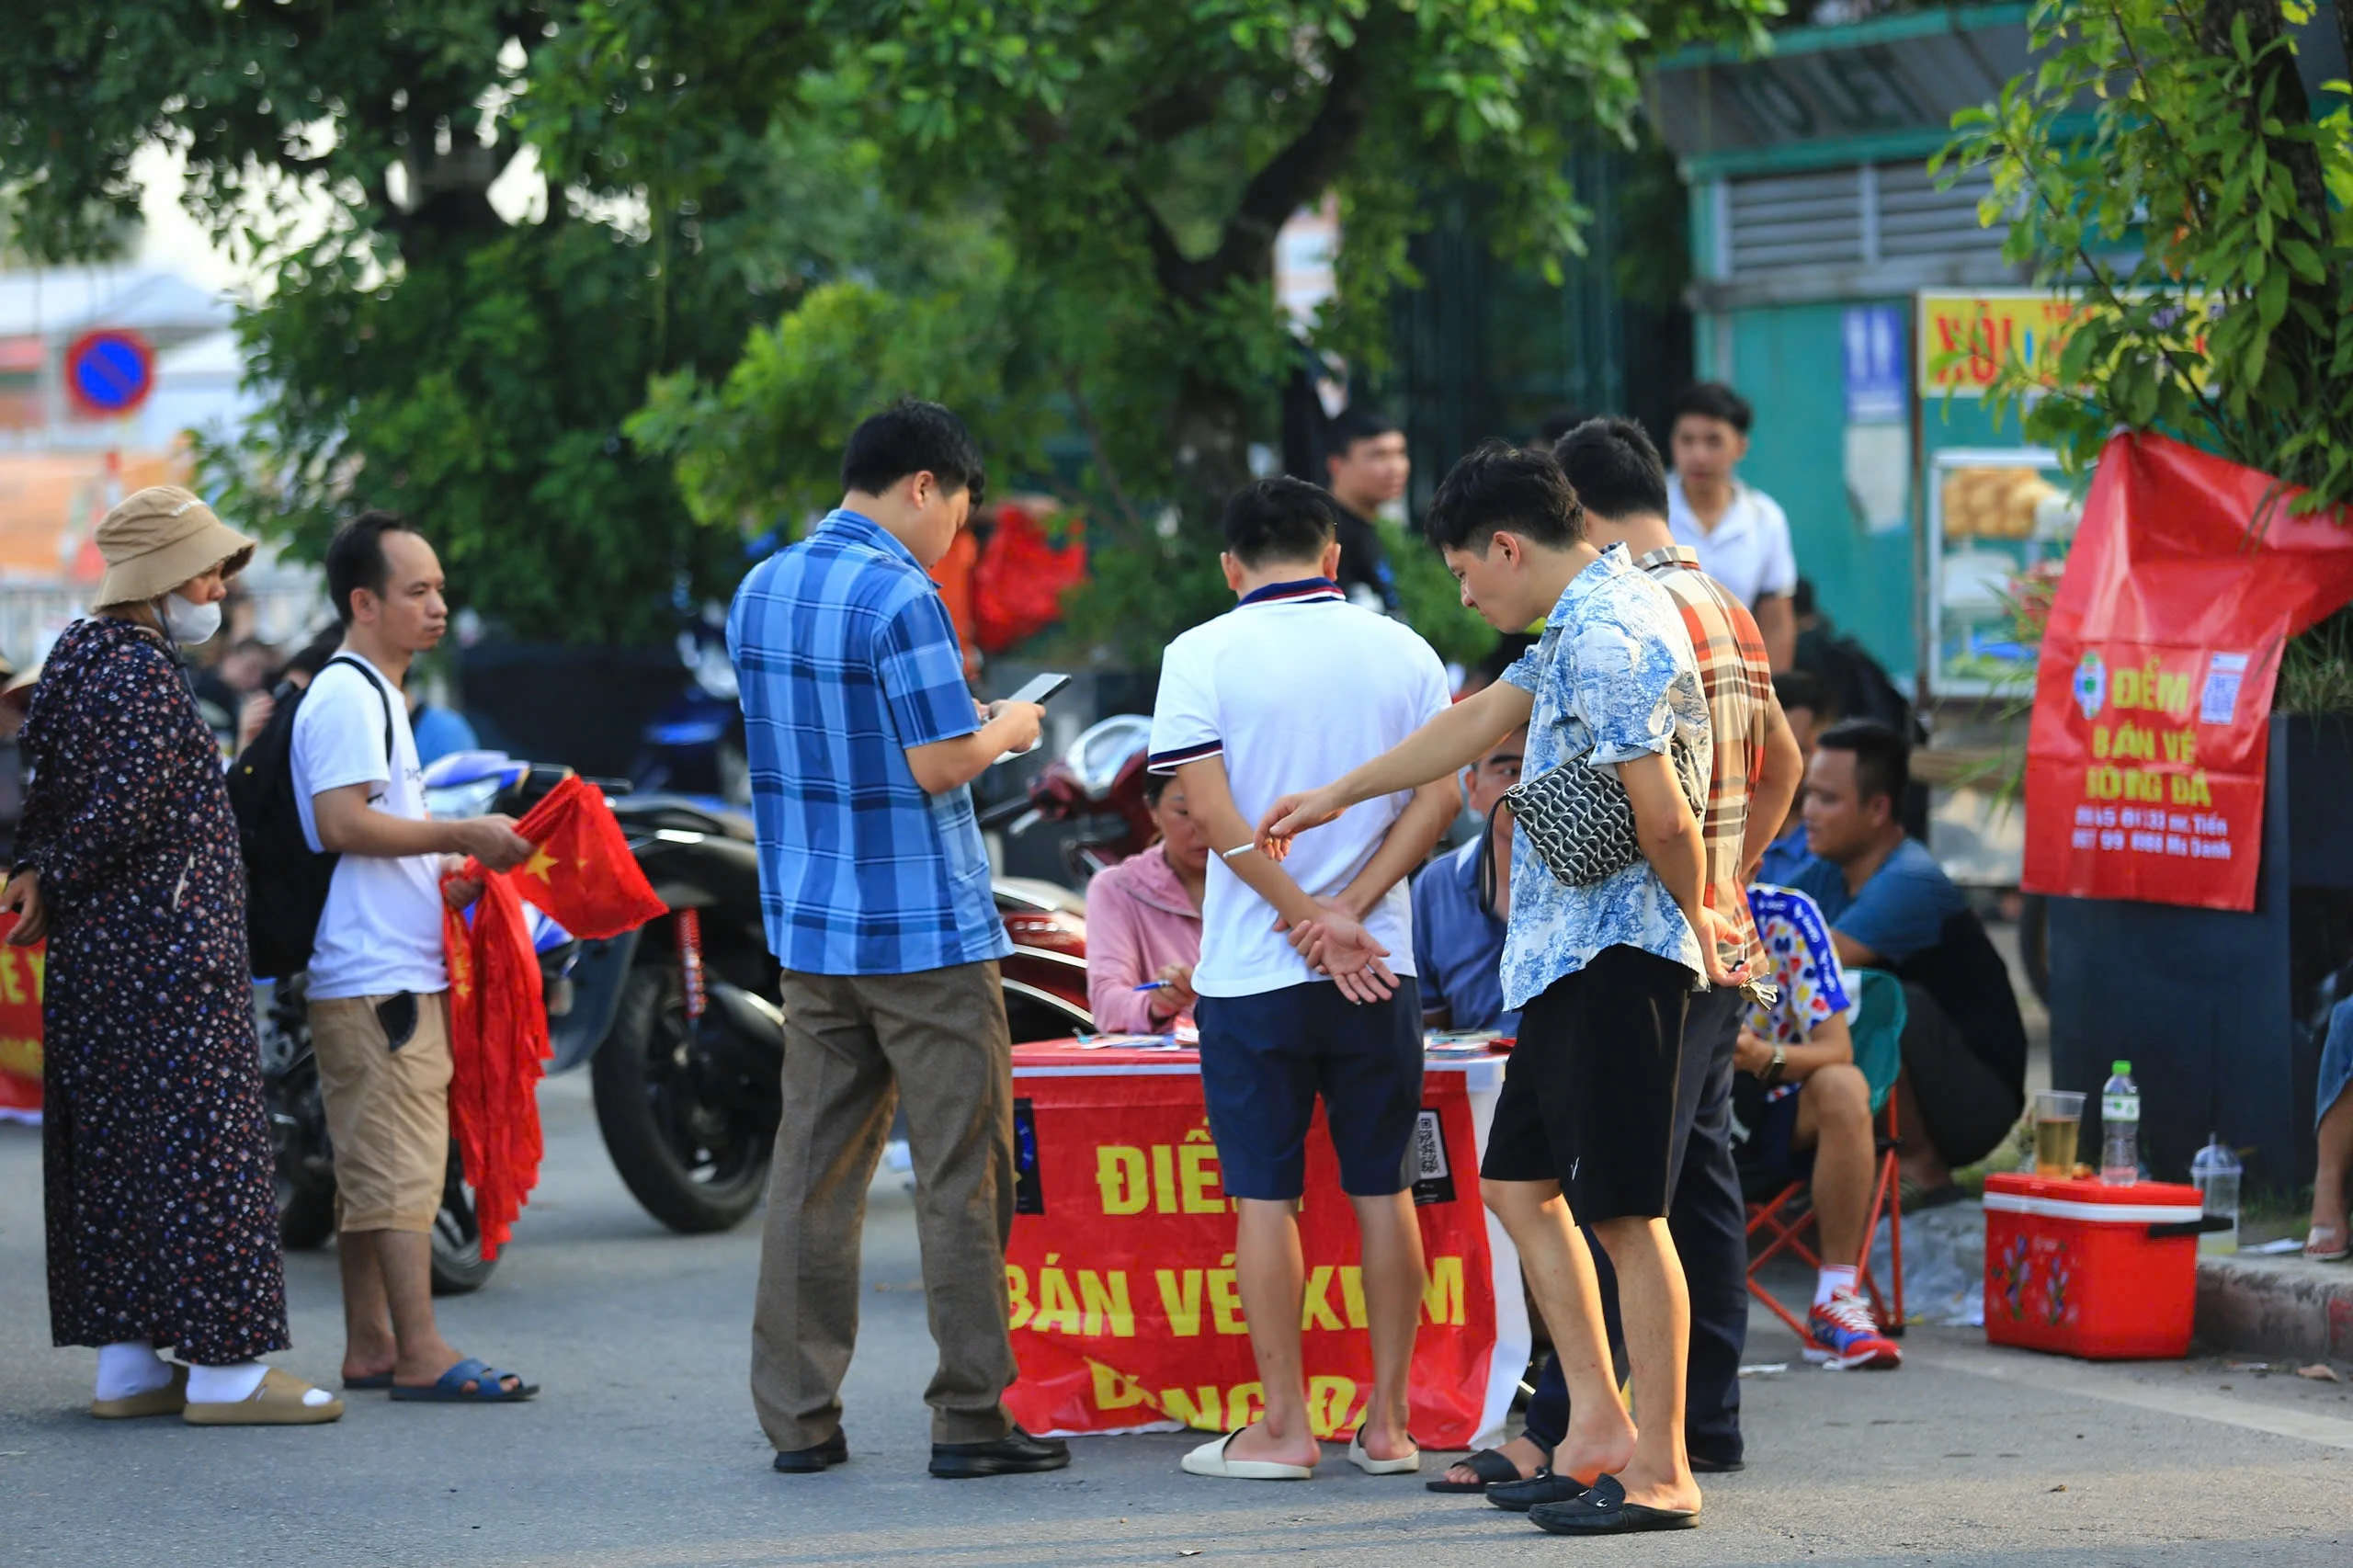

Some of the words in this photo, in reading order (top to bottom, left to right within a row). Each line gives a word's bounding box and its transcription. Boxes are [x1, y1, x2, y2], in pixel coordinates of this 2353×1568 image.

[1005, 1253, 1136, 1337] BÁN
[1154, 1253, 1250, 1336] VÉ
[1306, 1375, 1369, 1437] Đ
